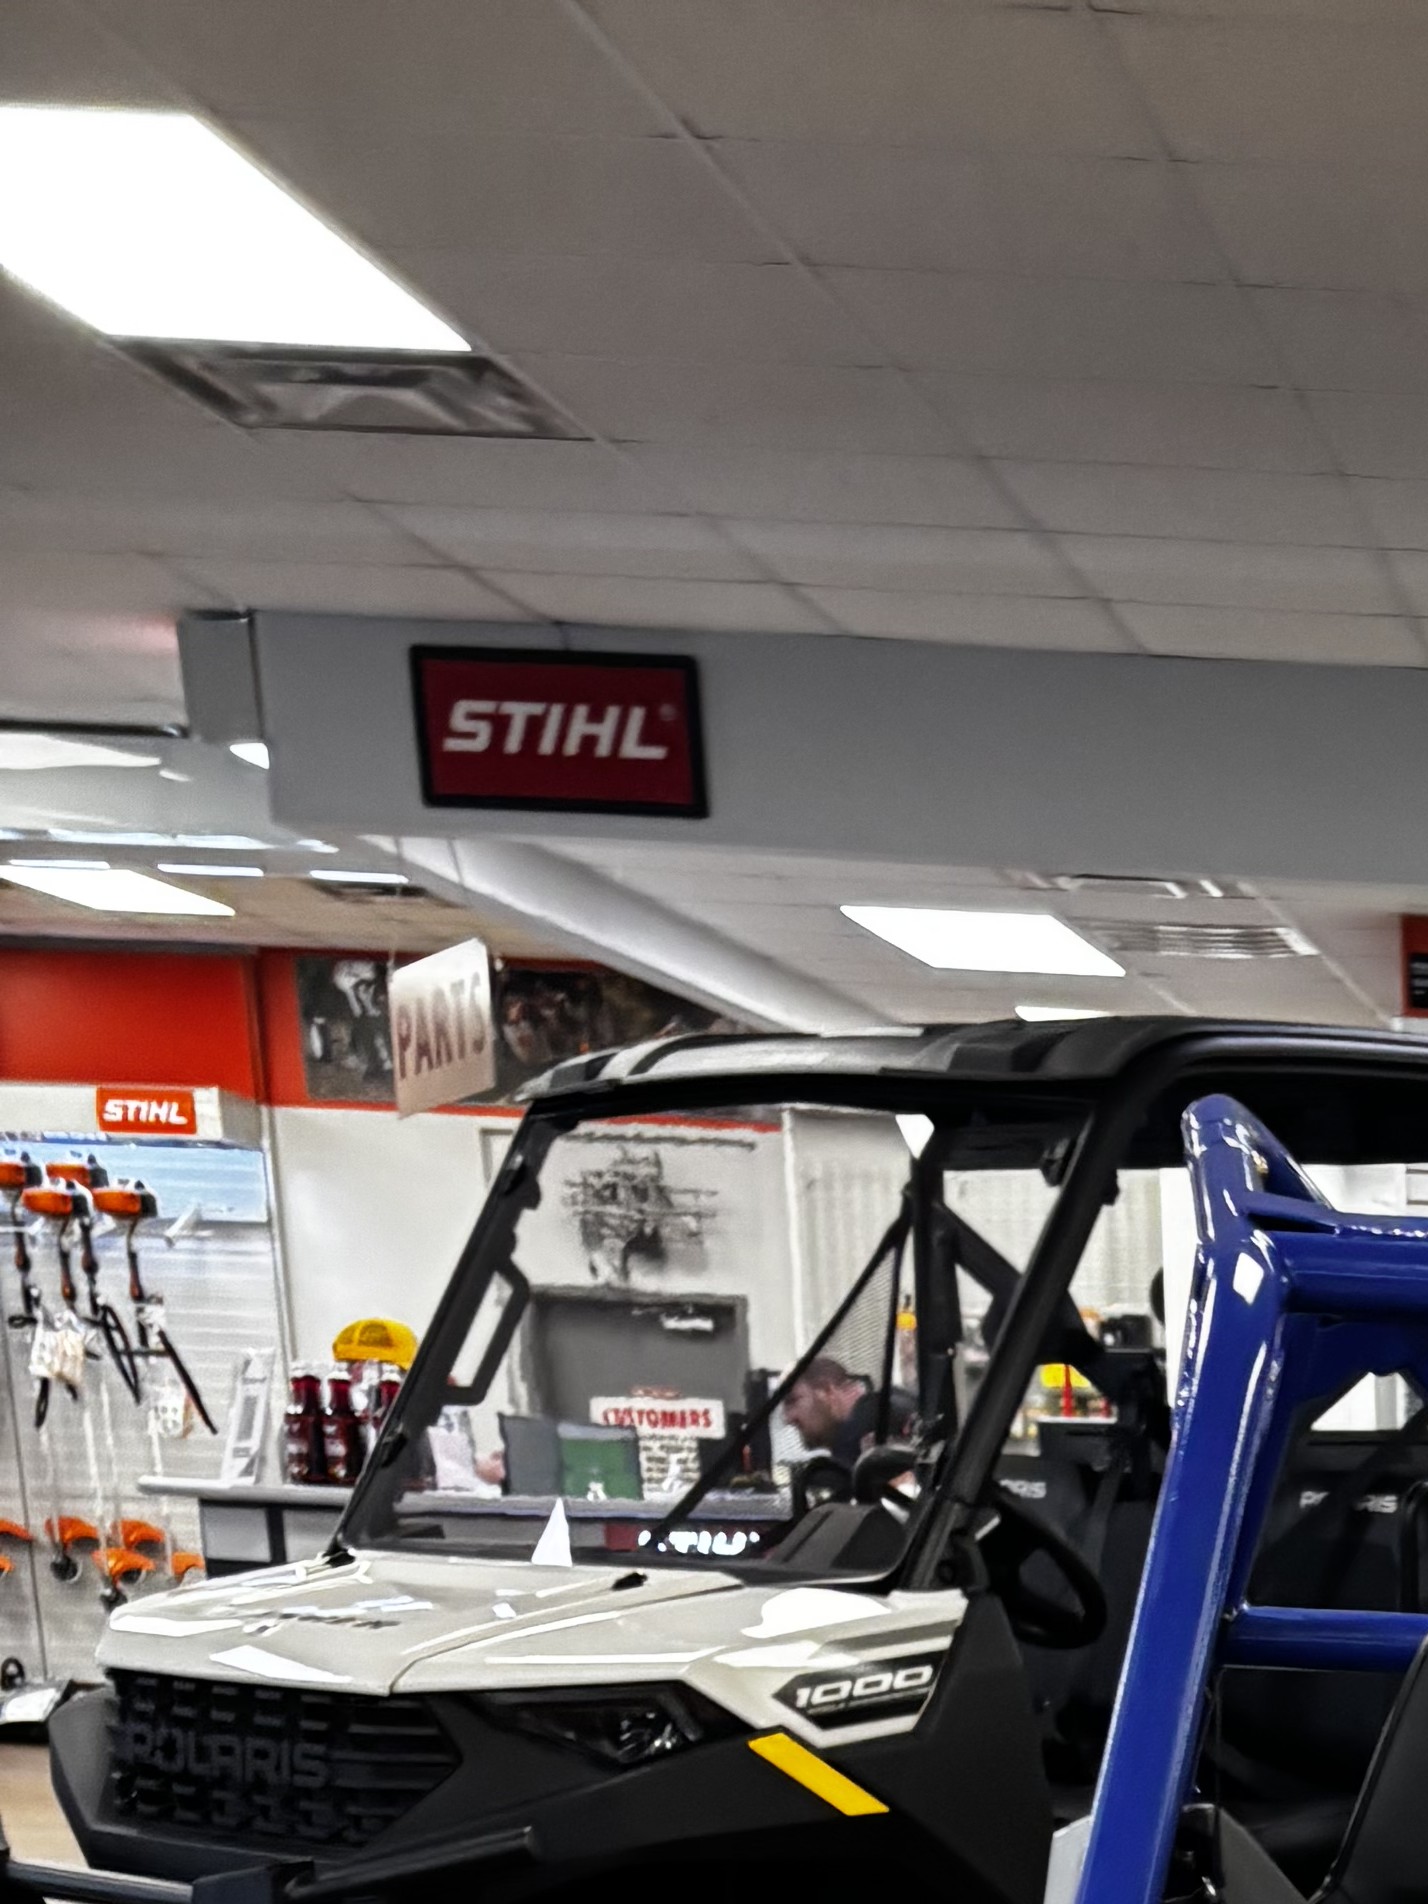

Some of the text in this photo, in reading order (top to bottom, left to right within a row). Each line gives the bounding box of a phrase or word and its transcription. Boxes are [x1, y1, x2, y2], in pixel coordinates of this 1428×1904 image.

[443, 699, 669, 759] STIHL
[398, 972, 485, 1080] PARTS
[103, 1099, 188, 1125] STIHL
[796, 1664, 934, 1708] 1000
[126, 1724, 328, 1789] POLARIS
